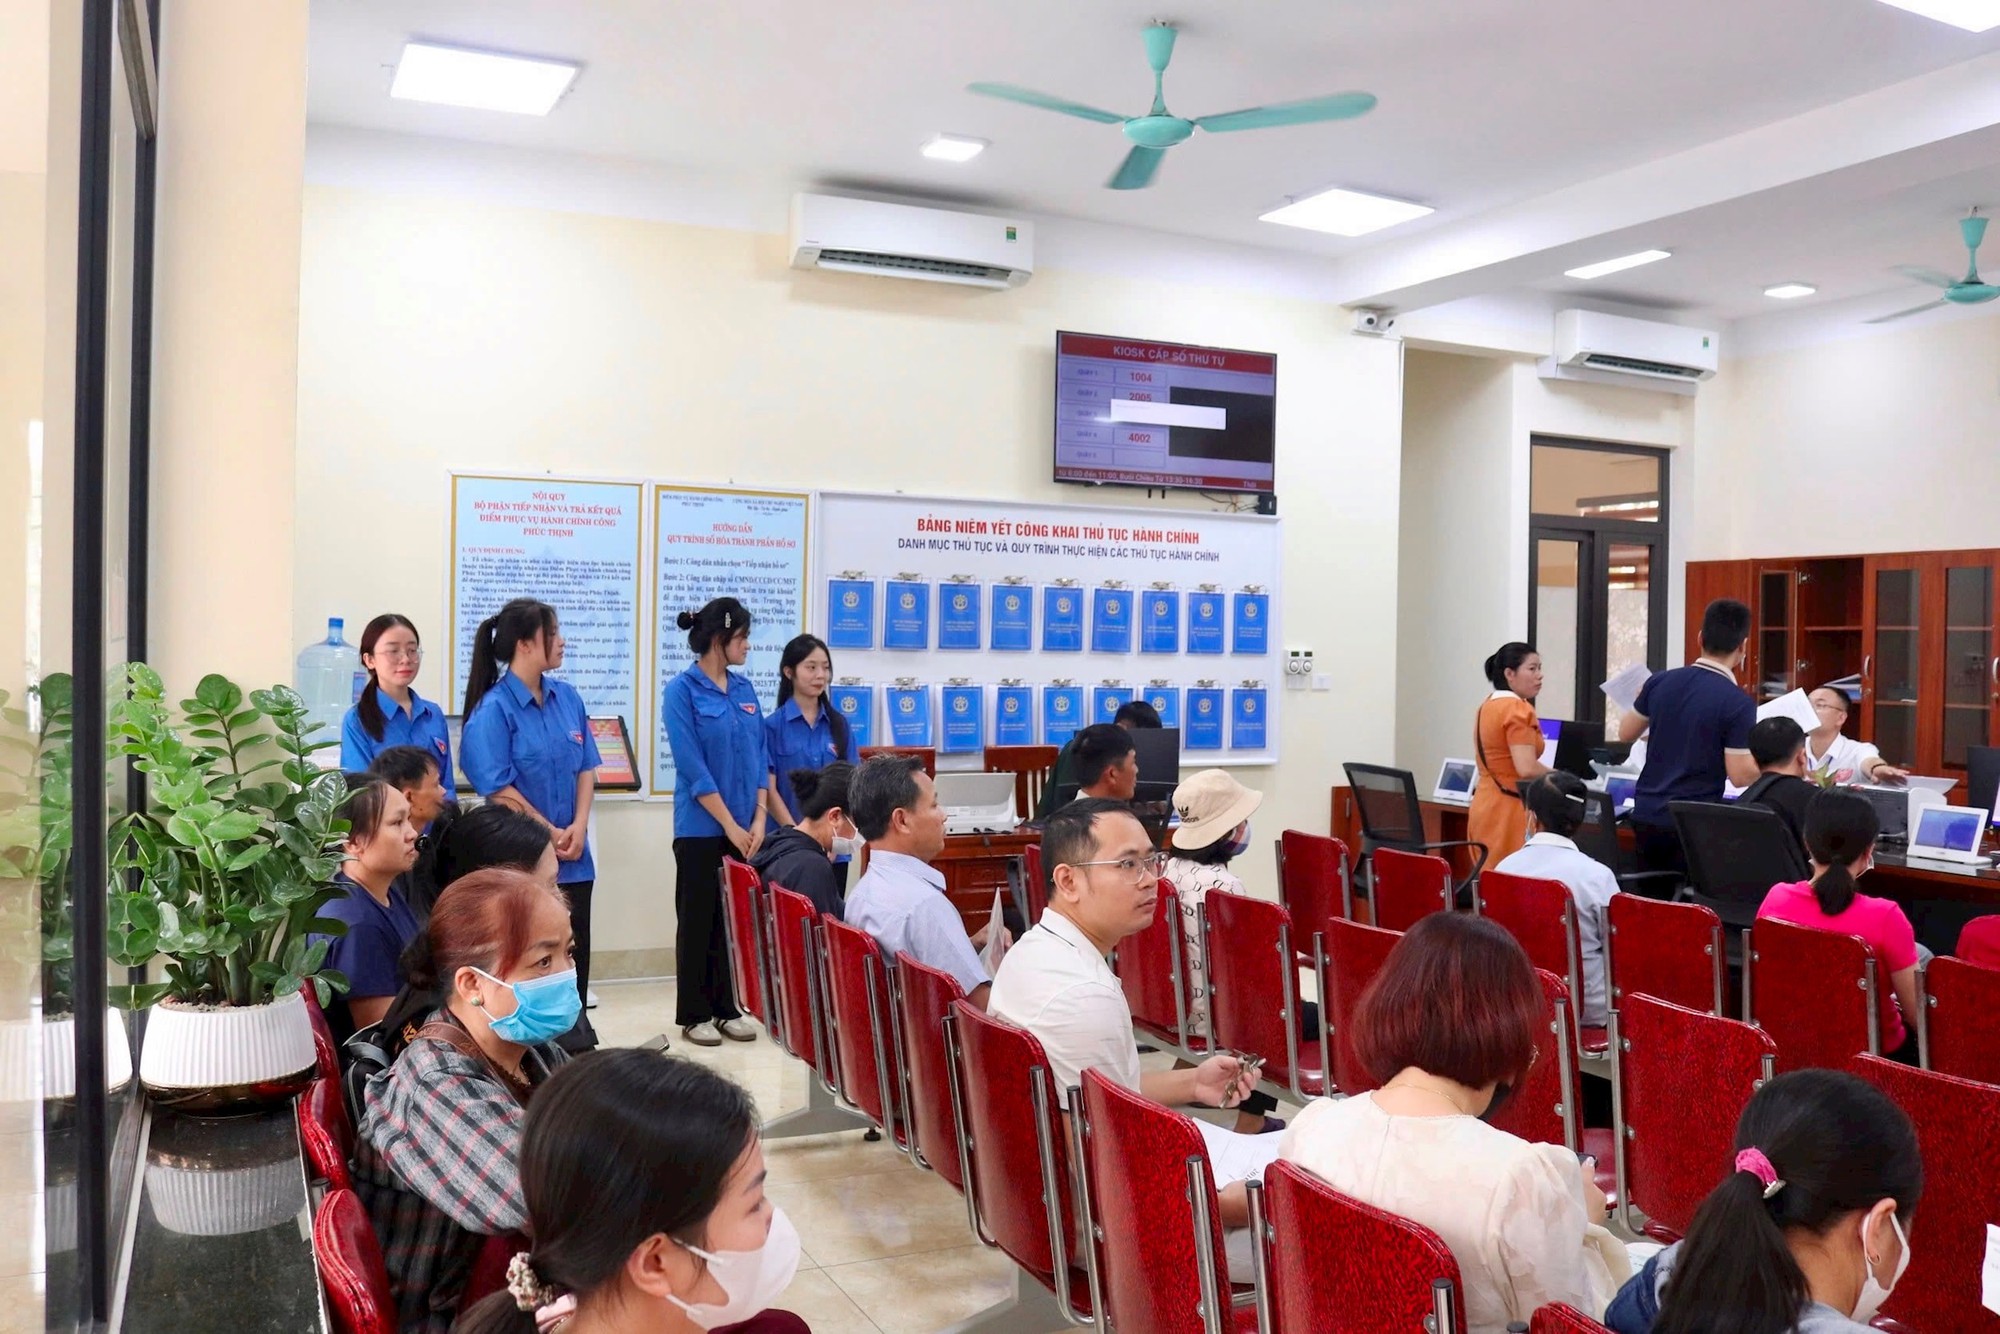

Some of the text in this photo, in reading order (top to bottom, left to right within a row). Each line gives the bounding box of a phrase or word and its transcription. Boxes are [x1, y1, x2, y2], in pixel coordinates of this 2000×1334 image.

[1113, 345, 1146, 359] KIOSK
[1130, 371, 1152, 382] 1004
[1129, 392, 1152, 402] 2005
[1128, 432, 1151, 443] 4002
[533, 491, 565, 501] NỘI QUY
[917, 513, 1199, 544] BẢNG NIÊM YẾT CÔNG KHAI THỦ TỤC HÀNH CHÍNH
[667, 535, 681, 544] QUY
[898, 536, 1220, 562] DANH MỤC THỦ TỤC VÀ QUY TRÌNH THỰC HIỆN CÁC THỦ TỤC HÀNH CHÍNH
